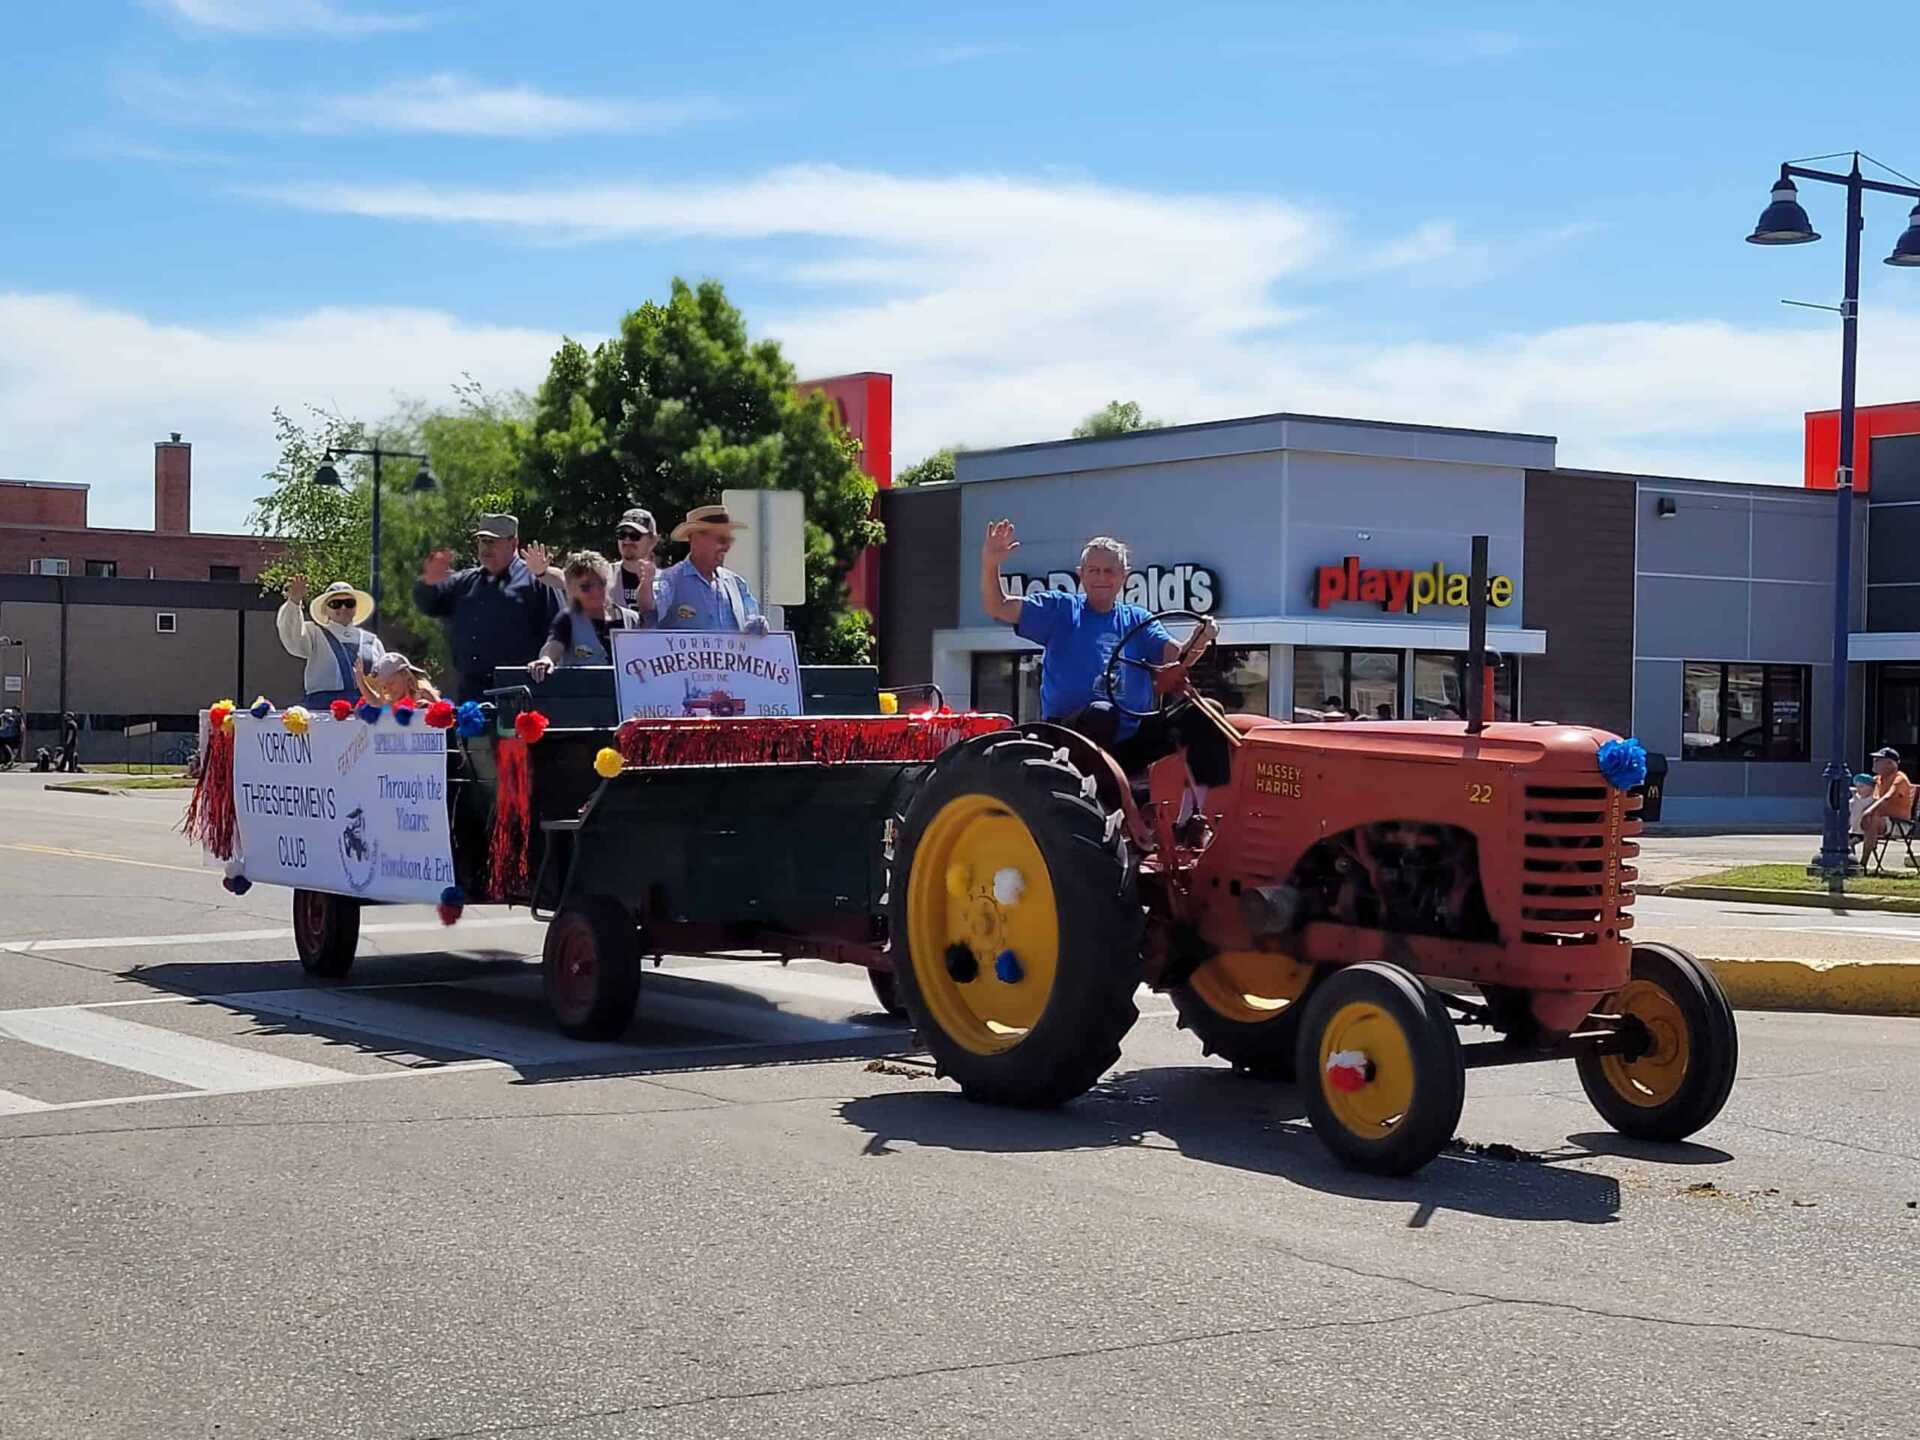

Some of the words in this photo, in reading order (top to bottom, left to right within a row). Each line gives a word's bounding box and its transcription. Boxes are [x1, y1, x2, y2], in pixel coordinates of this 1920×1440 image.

[1318, 555, 1514, 613] playplae
[666, 637, 747, 651] YORKTON
[625, 651, 790, 685] THRESHERMEN'S
[257, 733, 312, 764] YORKTON
[378, 774, 424, 804] Through
[427, 775, 442, 800] the
[1256, 779, 1301, 798] HARRIS
[1470, 784, 1492, 802] 22
[278, 835, 307, 868] CLUB
[423, 856, 432, 880] &
